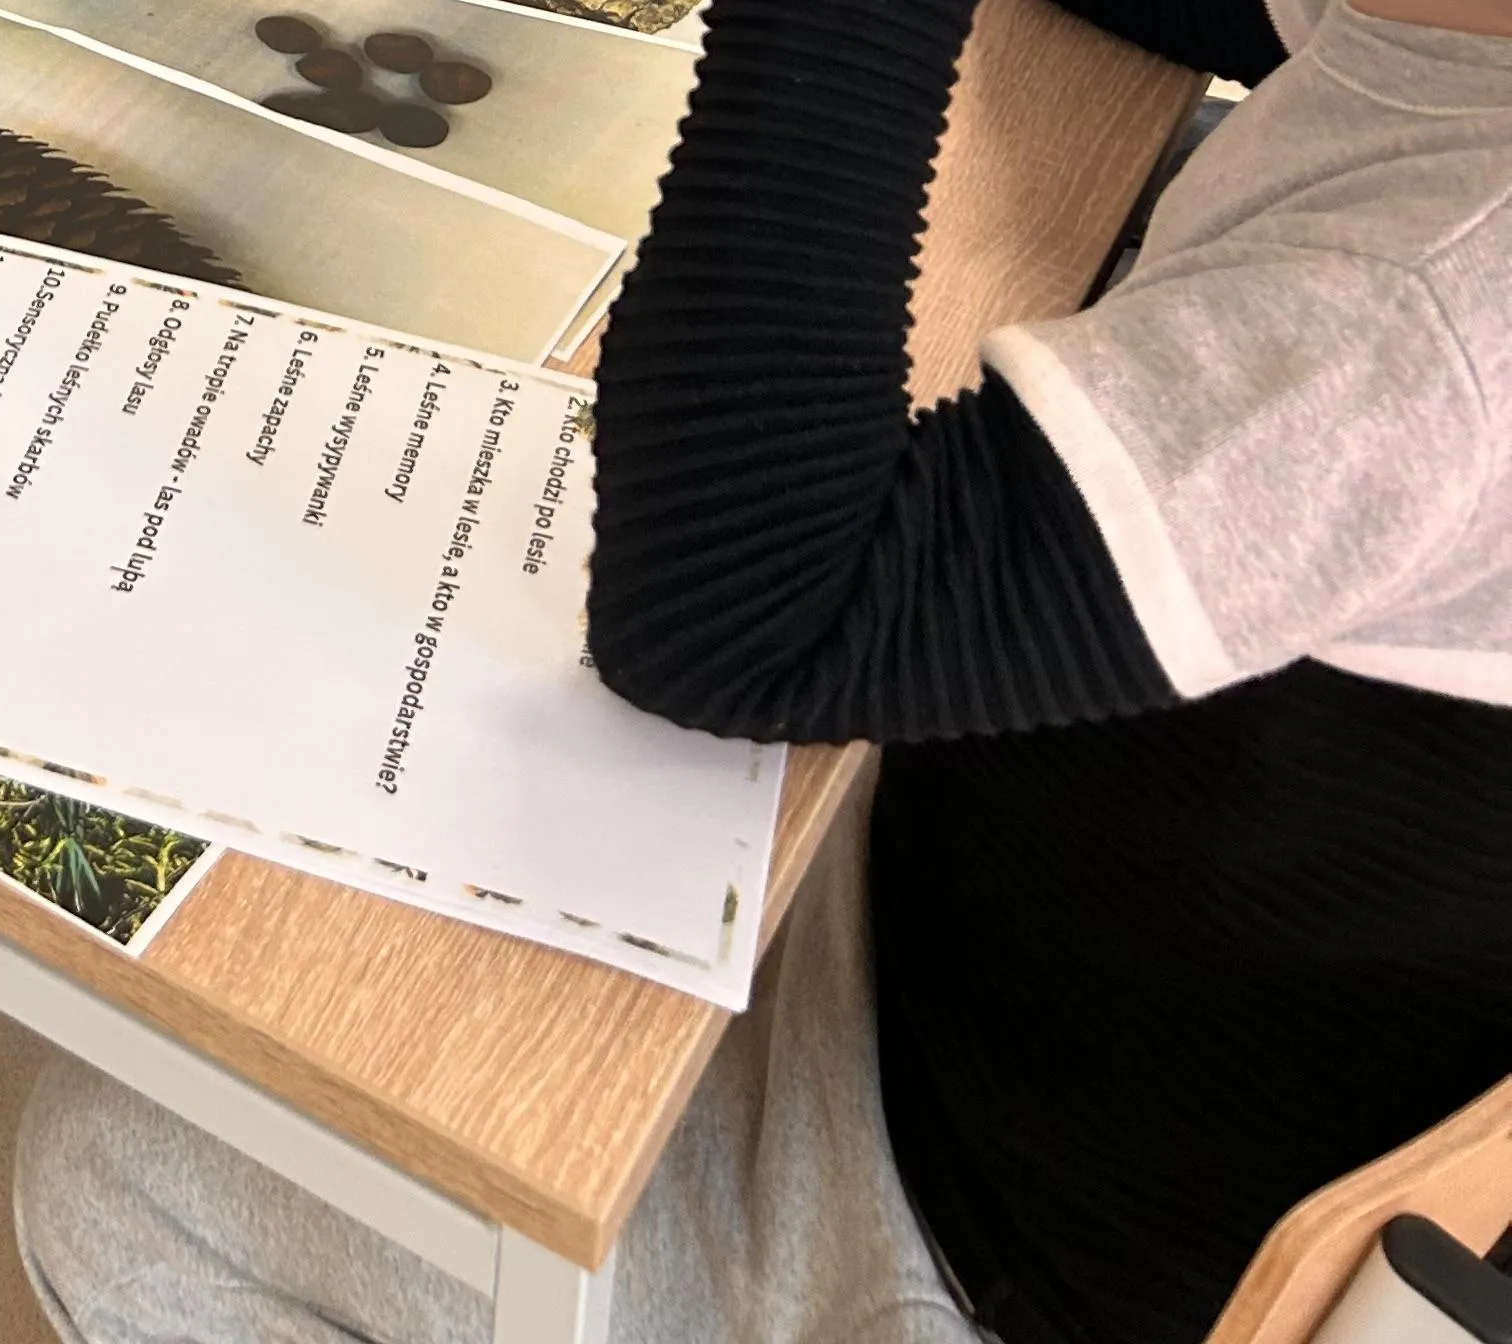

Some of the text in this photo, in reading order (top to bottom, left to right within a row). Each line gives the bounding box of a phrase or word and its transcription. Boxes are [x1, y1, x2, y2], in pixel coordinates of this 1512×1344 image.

[121, 299, 190, 416] 8. Odgłosy lasu
[223, 329, 249, 352] Na
[235, 313, 255, 327] 7.
[5, 283, 127, 500] 9. Pudełko leśnych skarbów
[202, 354, 238, 404] tropie
[245, 330, 318, 467] 6. Leśne zapachy
[169, 405, 211, 476] owadów
[301, 346, 385, 528] 5. Leśne wysypywanki
[384, 363, 451, 504] 4. Leśne memory
[136, 512, 164, 551] pod
[154, 484, 183, 512] las
[522, 395, 588, 575] 2. Kto chodzi po lesie
[110, 552, 153, 593] lupą
[375, 379, 519, 795] 3. Kto mieszka w lesie, a kto w gospodarstwie?
